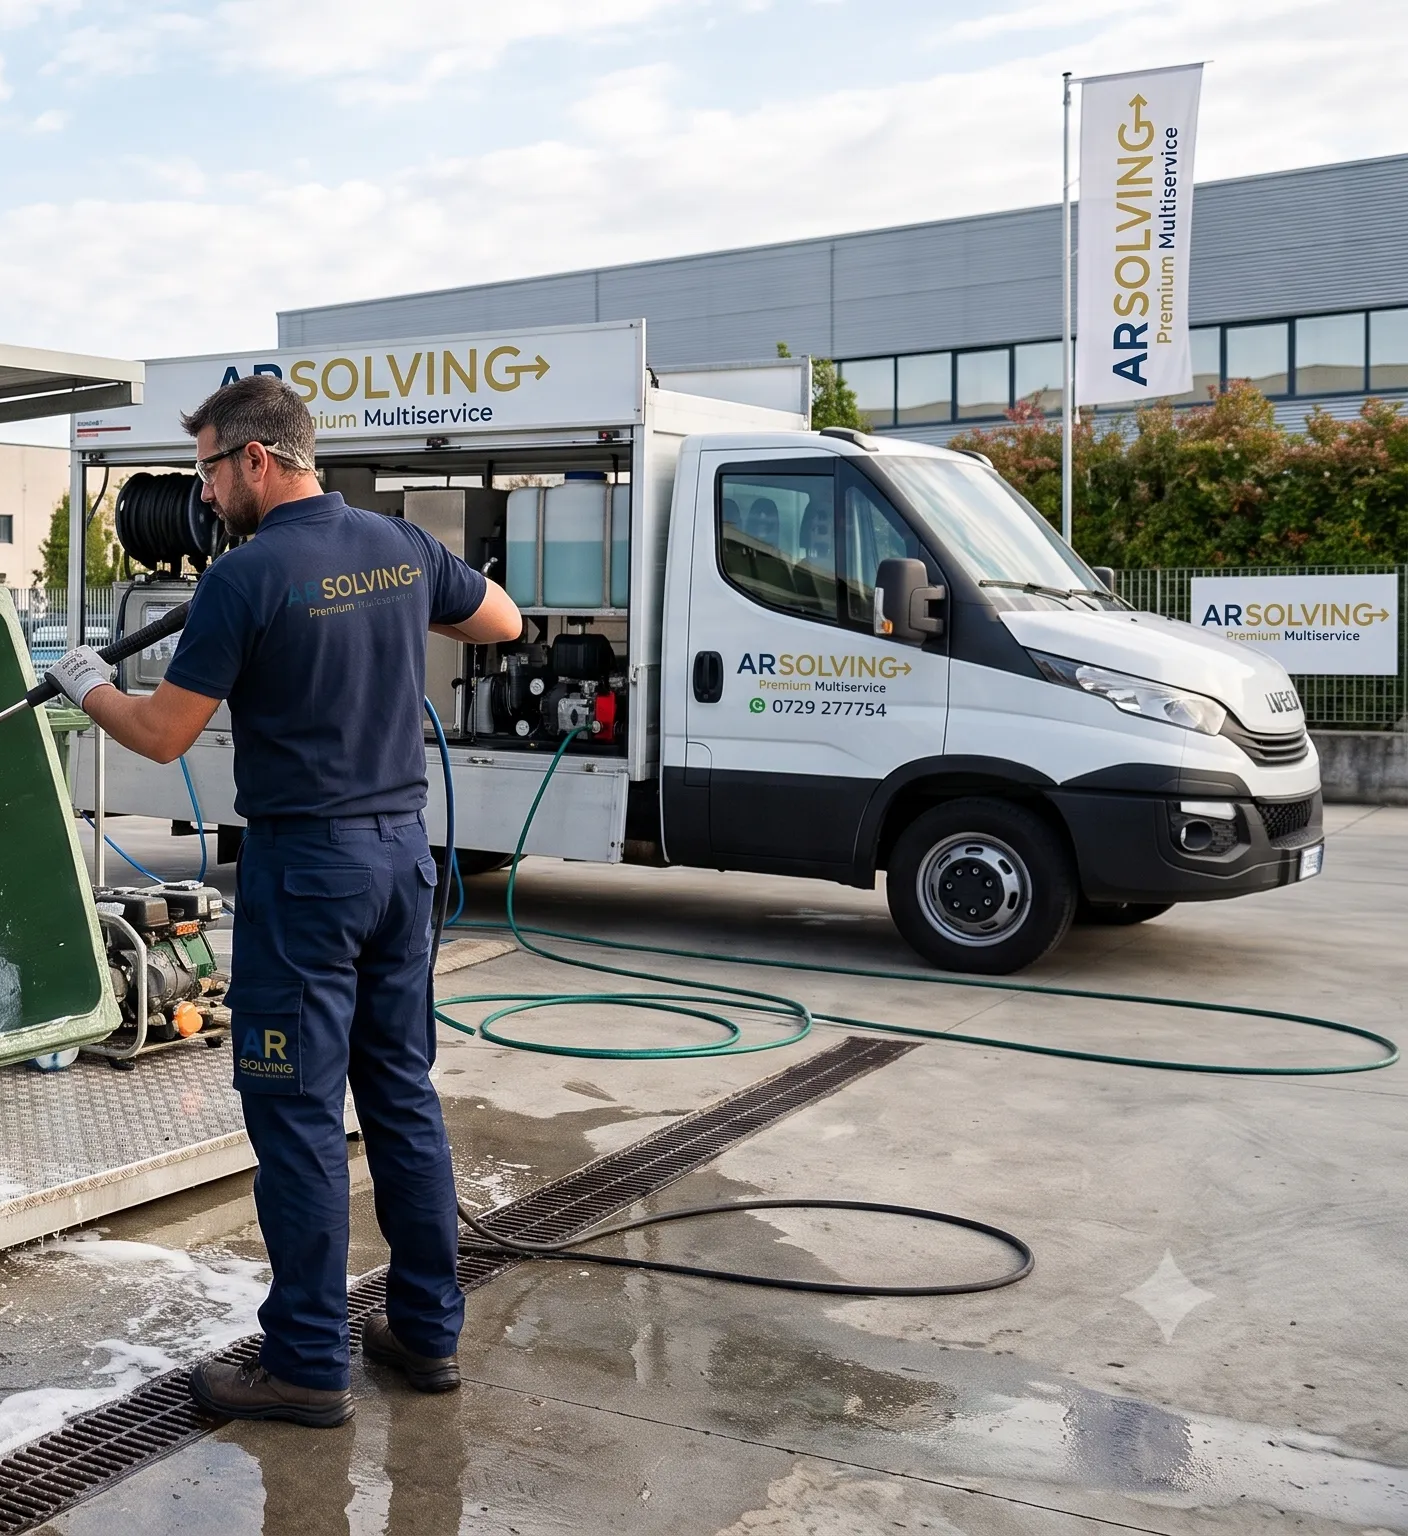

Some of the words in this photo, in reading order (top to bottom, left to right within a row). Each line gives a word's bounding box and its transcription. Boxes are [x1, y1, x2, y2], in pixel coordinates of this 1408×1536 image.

[1158, 127, 1178, 249] Multiservice
[1112, 119, 1155, 387] ARSOLVING
[1156, 256, 1175, 344] Premium
[364, 405, 494, 428] Multiservice
[286, 564, 414, 608] ARSOLVING
[309, 602, 355, 618] Premium
[1201, 602, 1374, 627] ARSOLVING
[1226, 631, 1282, 642] Premium
[1284, 629, 1361, 642] Multiservice
[737, 653, 898, 678] ARSOLVING
[759, 680, 811, 691] Premium
[815, 681, 887, 693] Multiservice
[772, 699, 816, 714] 0729
[821, 701, 887, 717] 277754
[240, 1027, 288, 1060] AR
[239, 1058, 294, 1074] SOLVING
